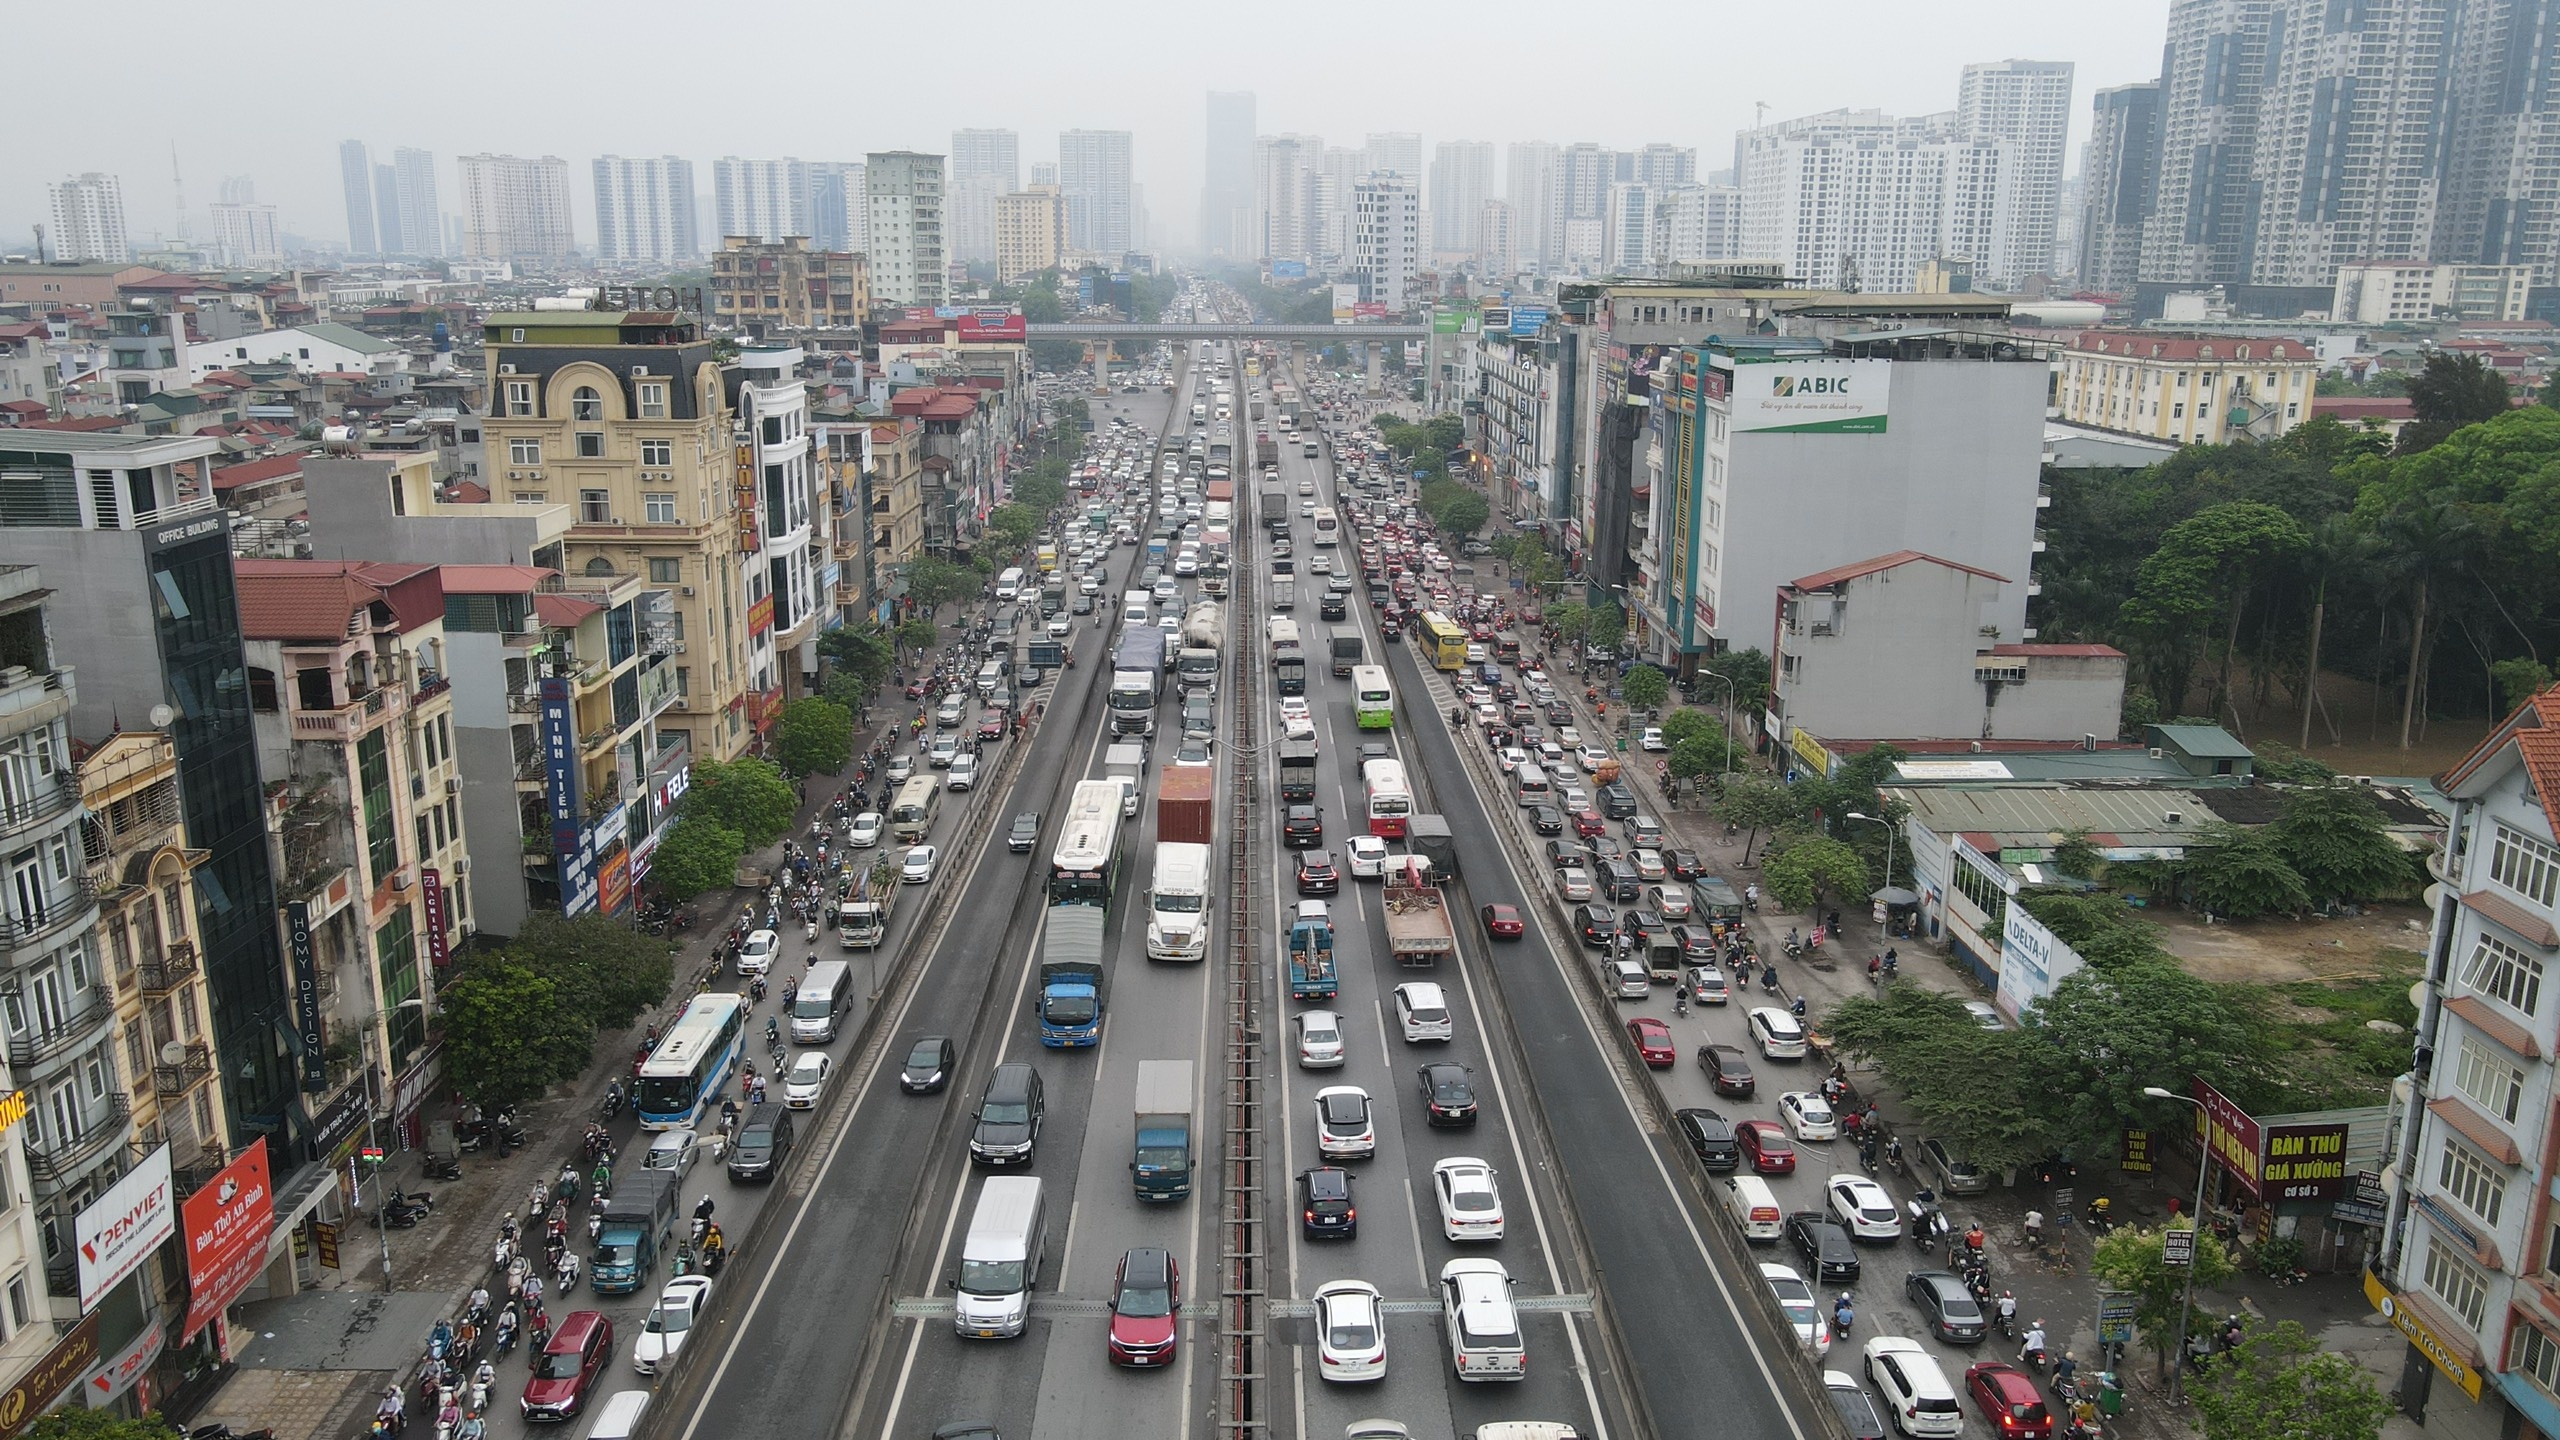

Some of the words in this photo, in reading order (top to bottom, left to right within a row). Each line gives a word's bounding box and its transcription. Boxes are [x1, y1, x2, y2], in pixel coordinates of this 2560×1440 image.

[1798, 377, 1849, 393] ABIC
[738, 447, 755, 550] HOTEL
[158, 527, 185, 544] OFFICE
[187, 518, 219, 536] BUILDING
[549, 708, 564, 759] MINH
[294, 918, 309, 970] HOMY
[427, 889, 443, 958] AGRIBANK
[2013, 922, 2049, 964] DELTA-V
[301, 980, 319, 1057] DESIGN
[2265, 1161, 2290, 1181] GIÁ
[2293, 1158, 2342, 1180] XƯỞNG
[2271, 1134, 2304, 1156] BÀN
[2309, 1132, 2342, 1154] THỜ
[104, 1182, 165, 1250] PENVIET
[2312, 1186, 2319, 1196] 3
[105, 1240, 124, 1262] DECOR
[124, 1233, 135, 1245] THE
[155, 1203, 166, 1219] LIFE
[195, 1228, 214, 1254] Bàn
[213, 1210, 232, 1233] Thờ
[232, 1204, 244, 1222] An
[244, 1183, 264, 1210] Bình
[2167, 1239, 2190, 1247] HOTEL
[191, 1289, 211, 1314] Bàn
[232, 1257, 246, 1276] An
[2397, 1309, 2418, 1337] Tiệm
[2420, 1331, 2435, 1353] Trà
[2436, 1347, 2464, 1382] Chanh
